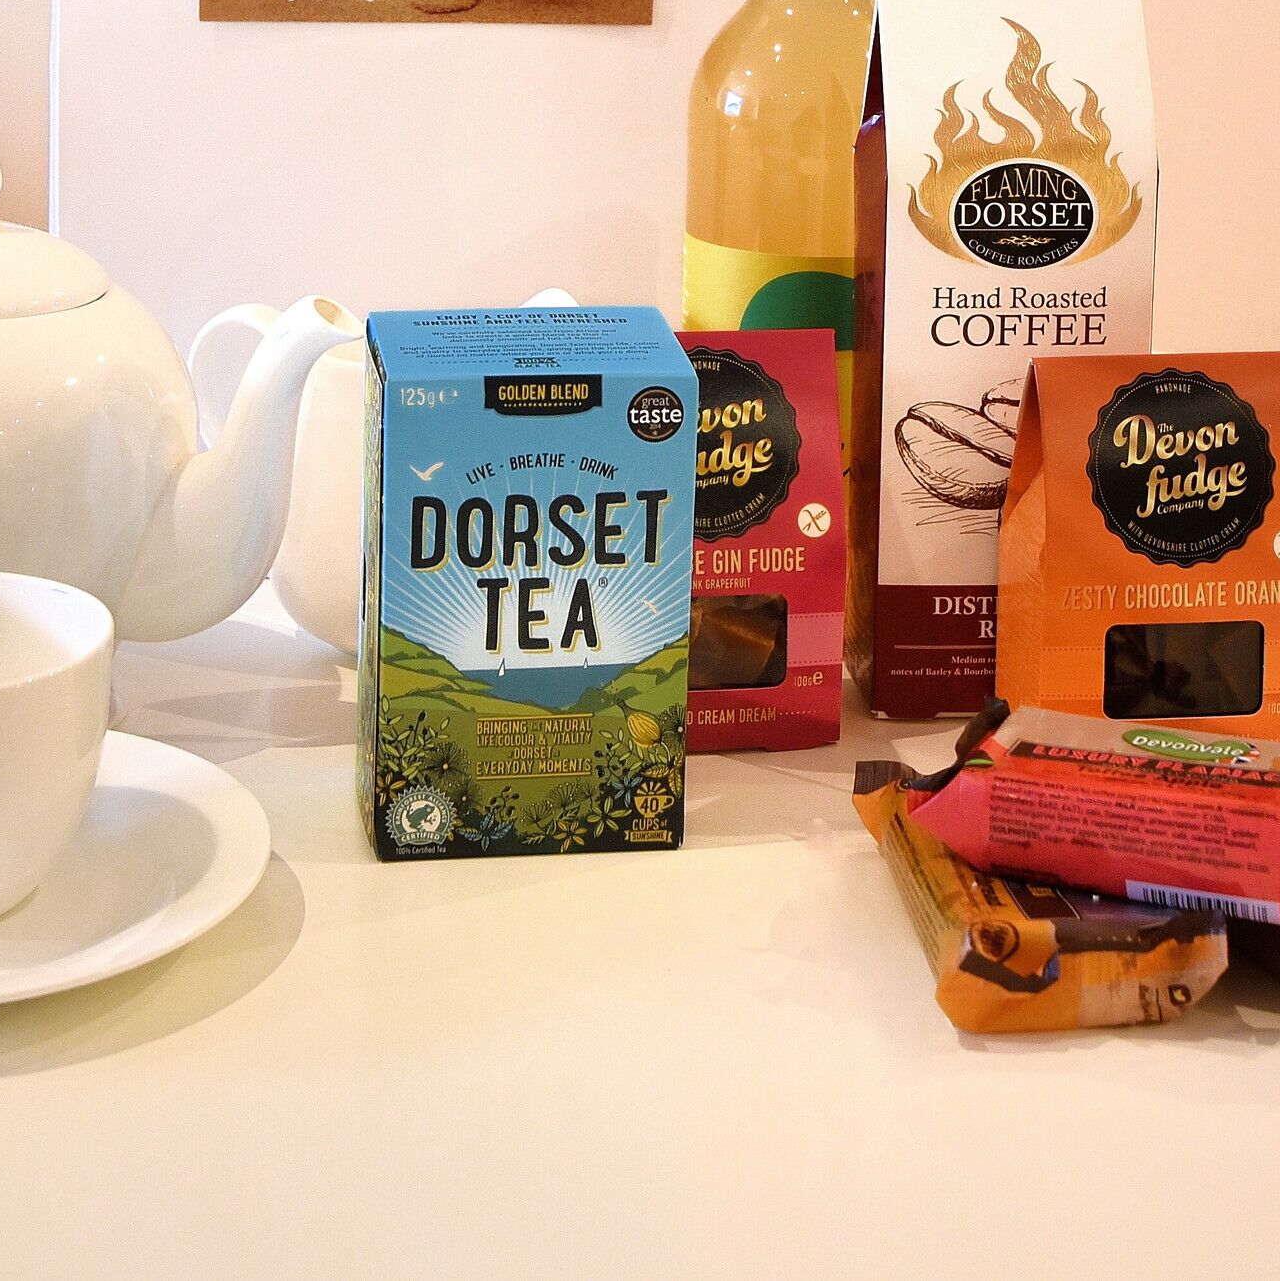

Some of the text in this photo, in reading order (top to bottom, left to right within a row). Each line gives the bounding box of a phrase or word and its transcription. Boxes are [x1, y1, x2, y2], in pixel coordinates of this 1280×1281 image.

[970, 167, 1077, 201] FLAMING
[957, 202, 1091, 228] DORSET
[967, 237, 1079, 266] COFFEE ROASTERS
[932, 286, 1108, 310] Hand Roasted
[413, 319, 480, 327] SUNSHINE
[930, 313, 1108, 347] COFFEE
[692, 359, 721, 372] NDMADE
[498, 383, 589, 401] GOLDEN BLEND
[1154, 382, 1192, 395] HANDMADE
[641, 396, 670, 409] great
[629, 407, 683, 424] taste
[696, 397, 768, 434] von
[1156, 422, 1174, 434] The
[1112, 413, 1241, 470] Devon
[696, 429, 775, 487] udge
[466, 452, 619, 485] LIVE BREATHE DRINK
[1135, 452, 1249, 519] fudge
[714, 509, 746, 528] CLOTTED
[744, 492, 767, 515] CREAM
[1156, 498, 1206, 516] Company
[409, 488, 672, 574] DORSET
[1126, 517, 1243, 554] WITH DEVONSHIRE CLOTTED CREAM
[712, 548, 742, 575] GIN
[748, 546, 806, 574] FUDGE
[693, 577, 752, 591] NK GRAPEFRUIT
[1063, 584, 1118, 611] ZESTY
[1124, 580, 1229, 610] CHOCOLATE
[475, 576, 602, 655] TEA
[951, 655, 986, 665] Medium
[890, 666, 997, 678] notes of Barley & Bourbo
[697, 708, 736, 726] CREAM
[739, 706, 777, 724] DREAM
[476, 721, 528, 736] BRINGING
[544, 718, 592, 733] NATURAL
[538, 732, 546, 746] &
[551, 730, 592, 745] VITALITY
[1131, 734, 1245, 757] Devonvale
[514, 746, 553, 760] DORSET
[1031, 744, 1148, 768] LUXURY
[476, 758, 593, 776] EVERYDAY MOMENTS
[639, 797, 660, 814] 40
[632, 817, 660, 831] CUPS
[400, 832, 441, 843] CERTIFIED
[631, 830, 668, 841] SUNSHINE
